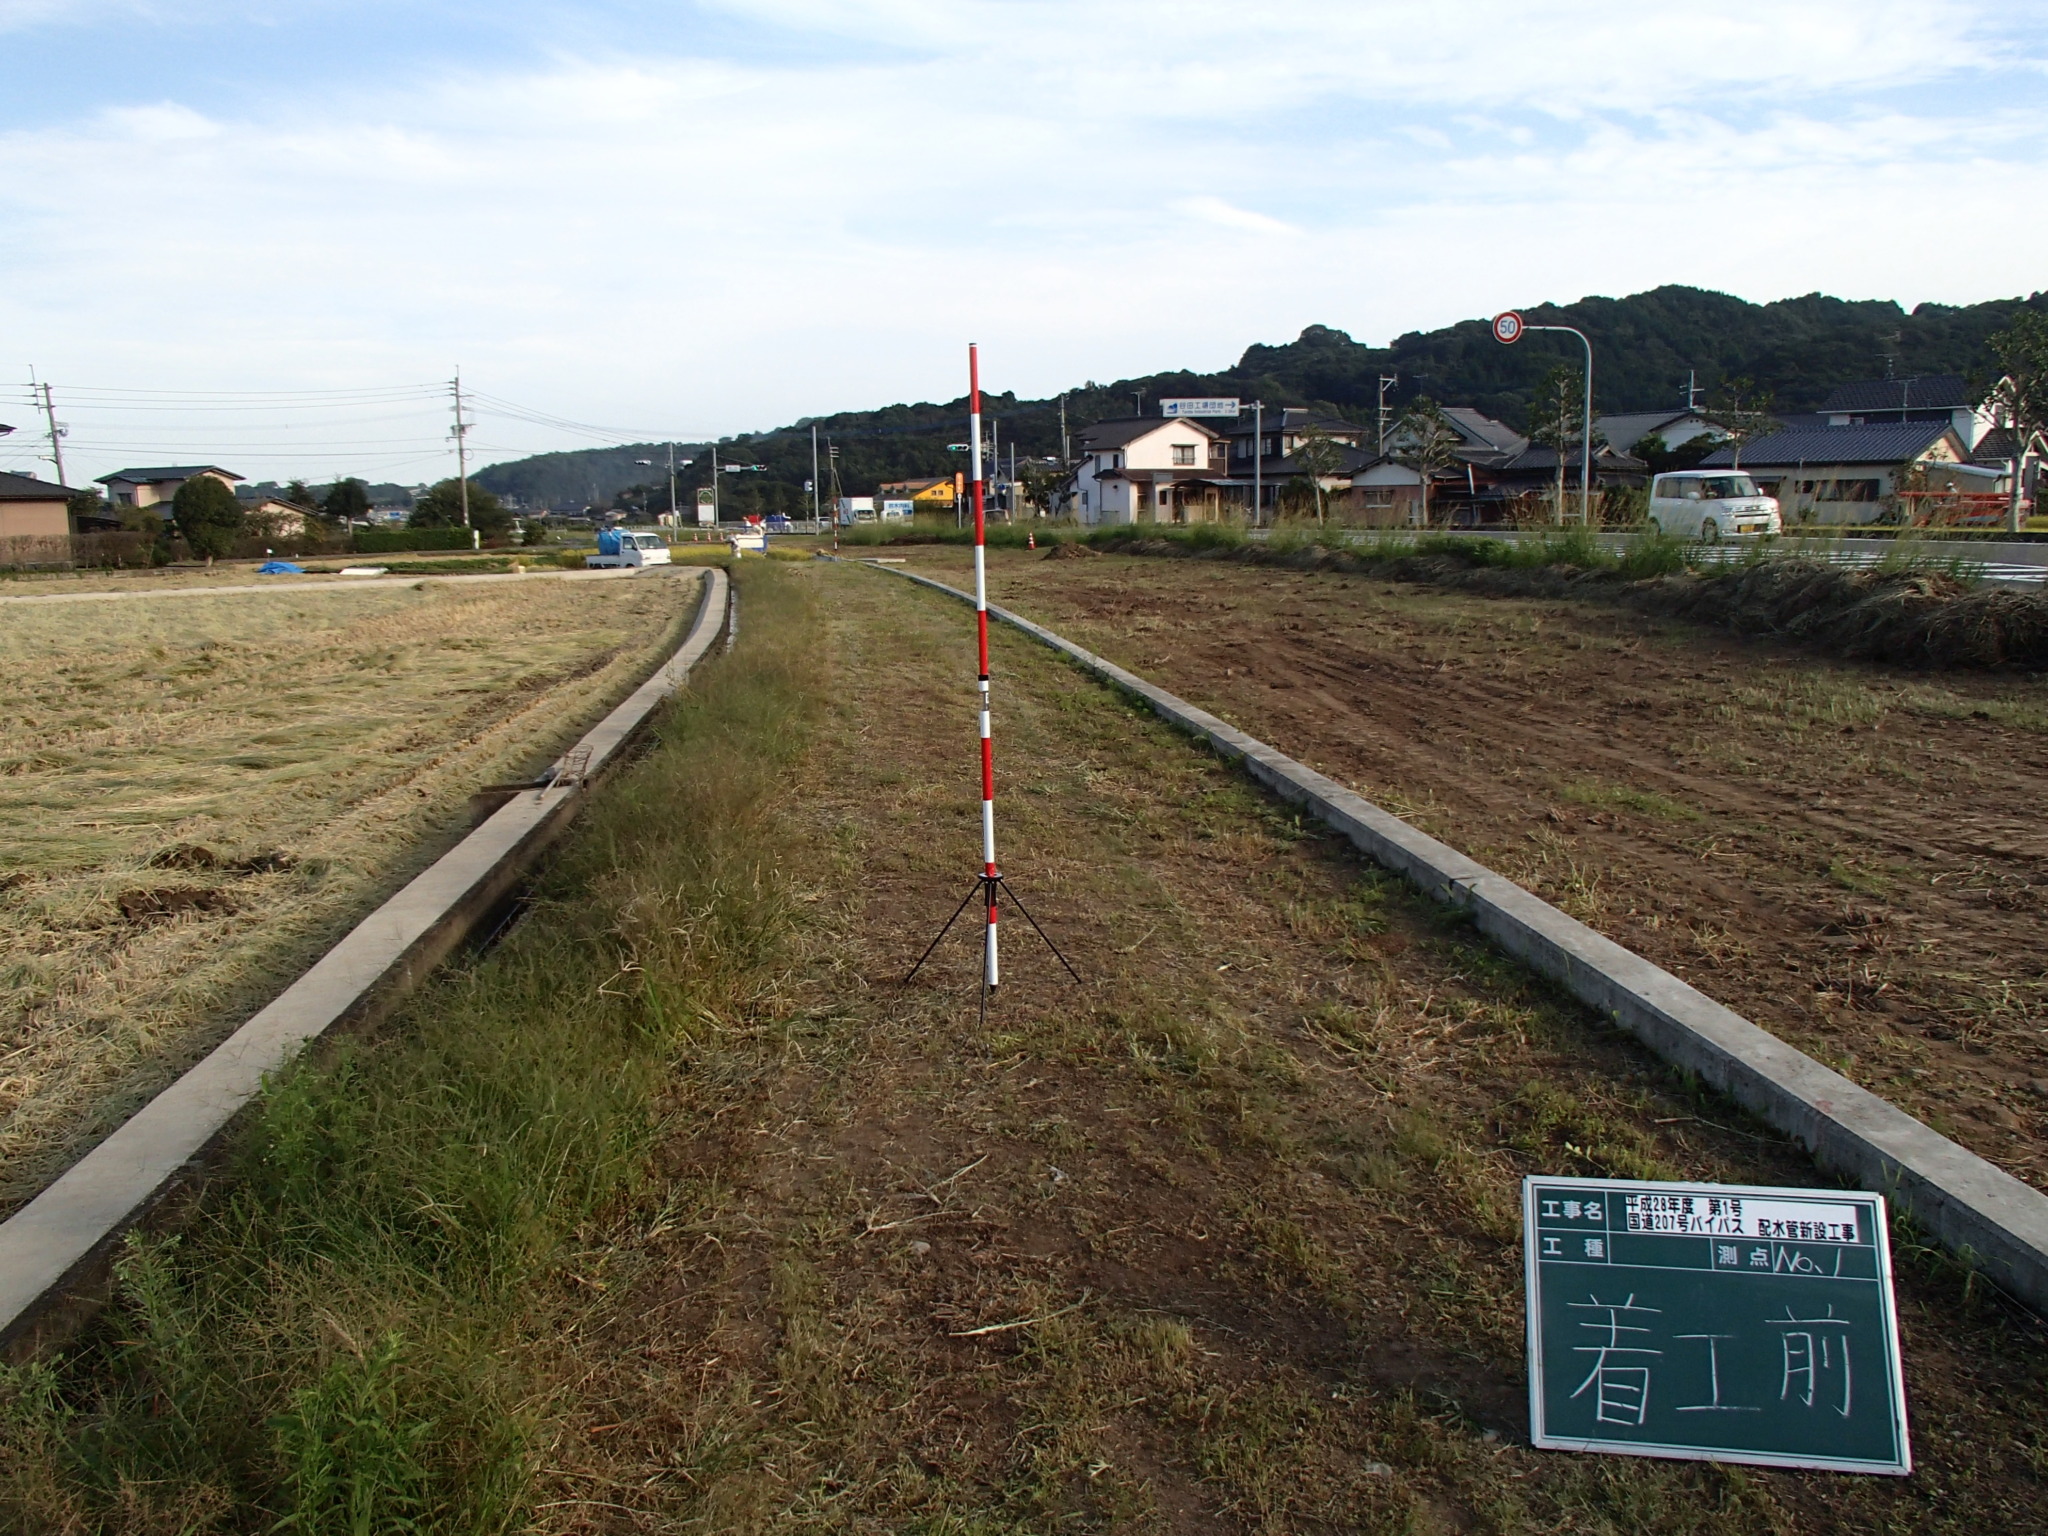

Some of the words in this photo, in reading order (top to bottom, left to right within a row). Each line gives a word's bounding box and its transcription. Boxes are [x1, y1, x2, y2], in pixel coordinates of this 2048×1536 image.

[1500, 320, 1516, 334] 50
[1541, 1200, 1602, 1220] 工事名
[1625, 1194, 1695, 1215] 平成28年度
[1708, 1198, 1743, 1218] 第1号
[1627, 1212, 1744, 1234] 国道207号バイパス
[1757, 1218, 1855, 1242] 配水管新設工事
[1566, 1293, 1850, 1425] 着工前
